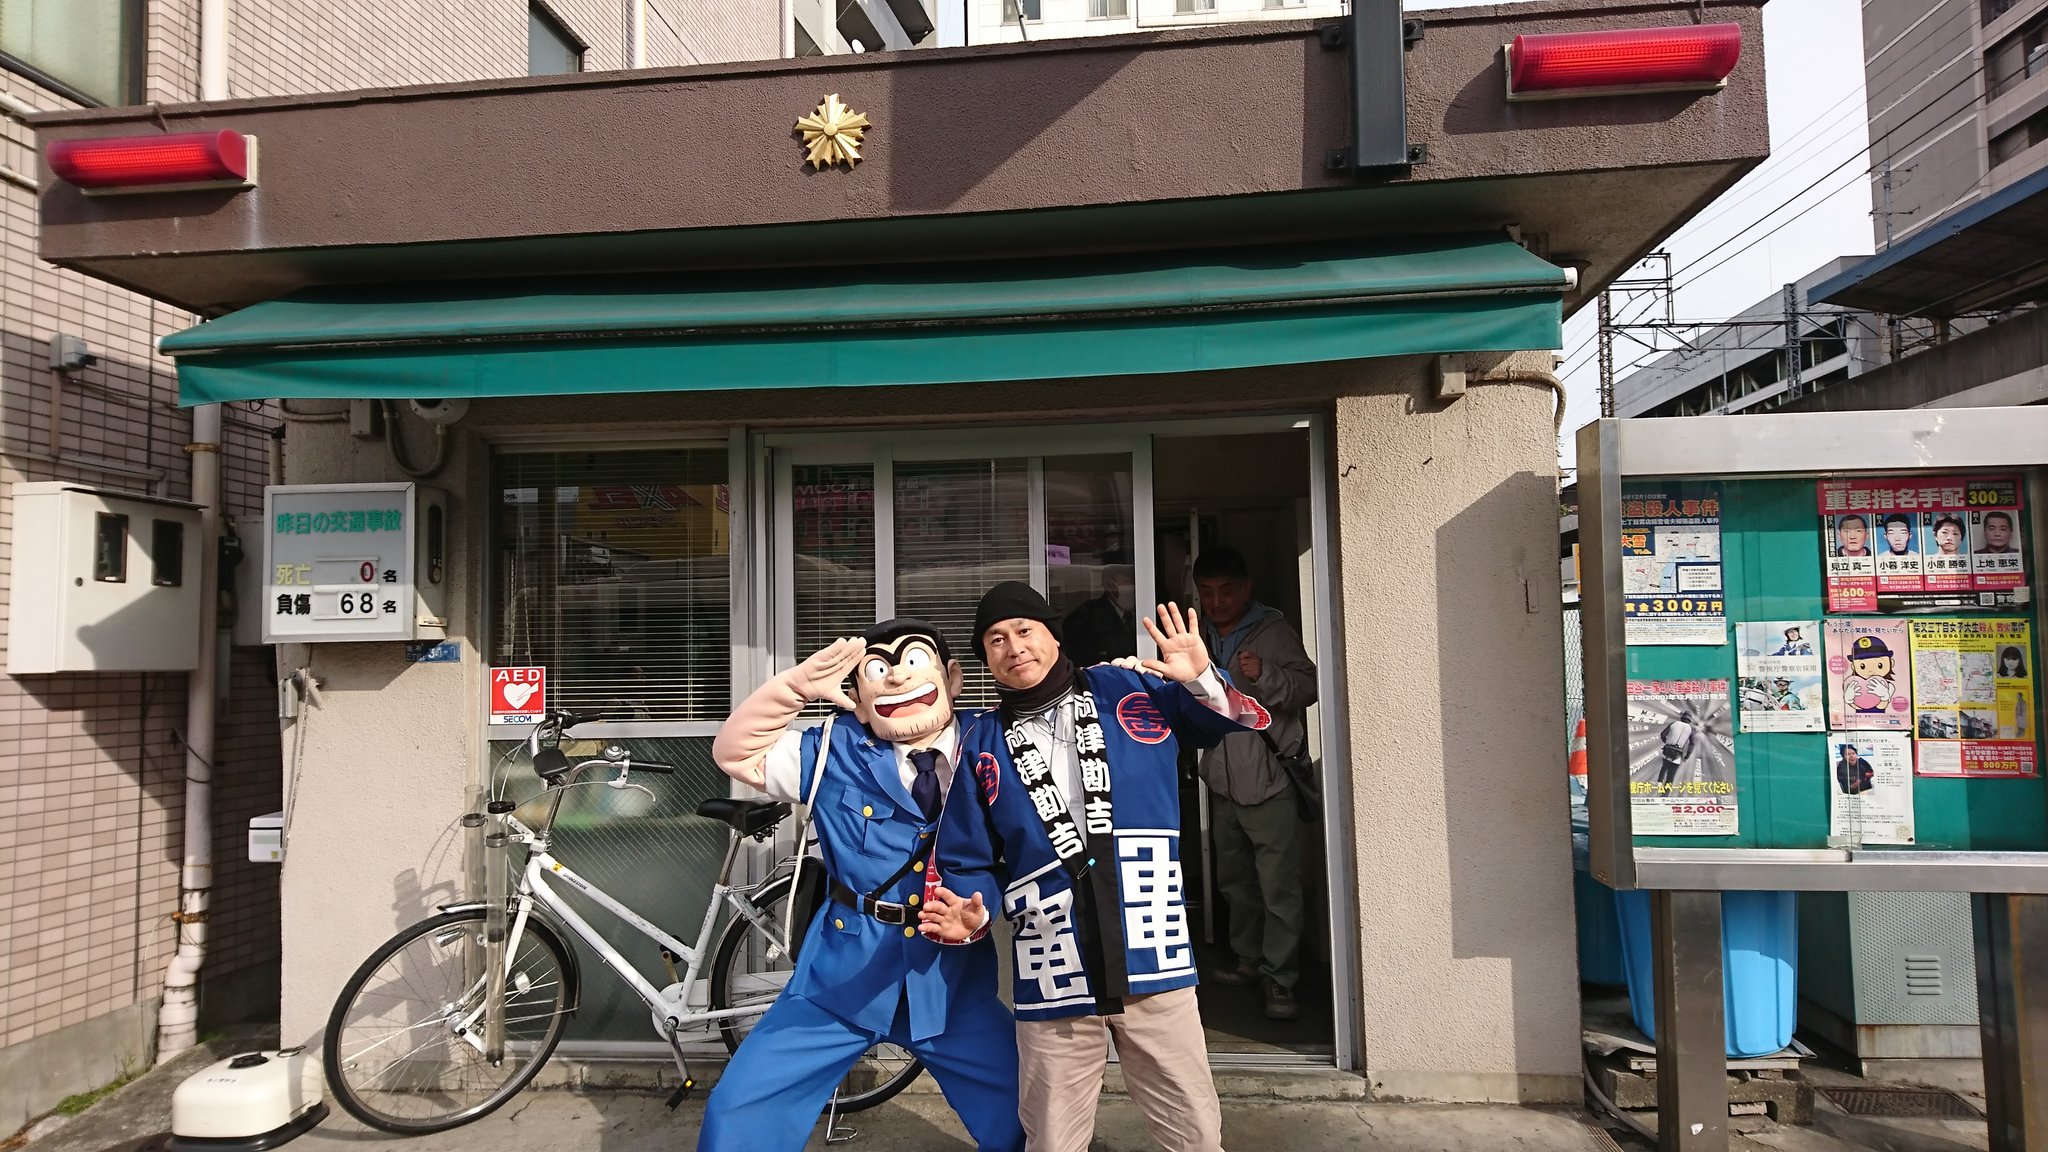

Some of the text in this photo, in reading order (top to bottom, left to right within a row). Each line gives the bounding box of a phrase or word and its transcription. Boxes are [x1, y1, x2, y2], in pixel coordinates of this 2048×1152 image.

[1825, 487, 1965, 510] 重要指名手配
[1968, 490, 1998, 504] 300
[275, 508, 402, 535] 昨日の交通事故
[1831, 562, 1871, 571] 見立 真一
[1880, 561, 1919, 570] 小暮 洋史
[1927, 560, 1968, 569] 小原 勝幸
[1976, 559, 1995, 568] 上地
[276, 561, 397, 585] 死亡 0 名
[1843, 588, 1864, 597] 600
[276, 593, 397, 615] 負傷 68 名
[1759, 665, 1817, 673] 警視庁警察官採用
[495, 669, 541, 682] AED
[503, 715, 532, 723] SECOM
[1074, 690, 1113, 835] 両津勘吉
[1983, 761, 2018, 769] 800万円
[1004, 720, 1084, 859] 両津勘吉
